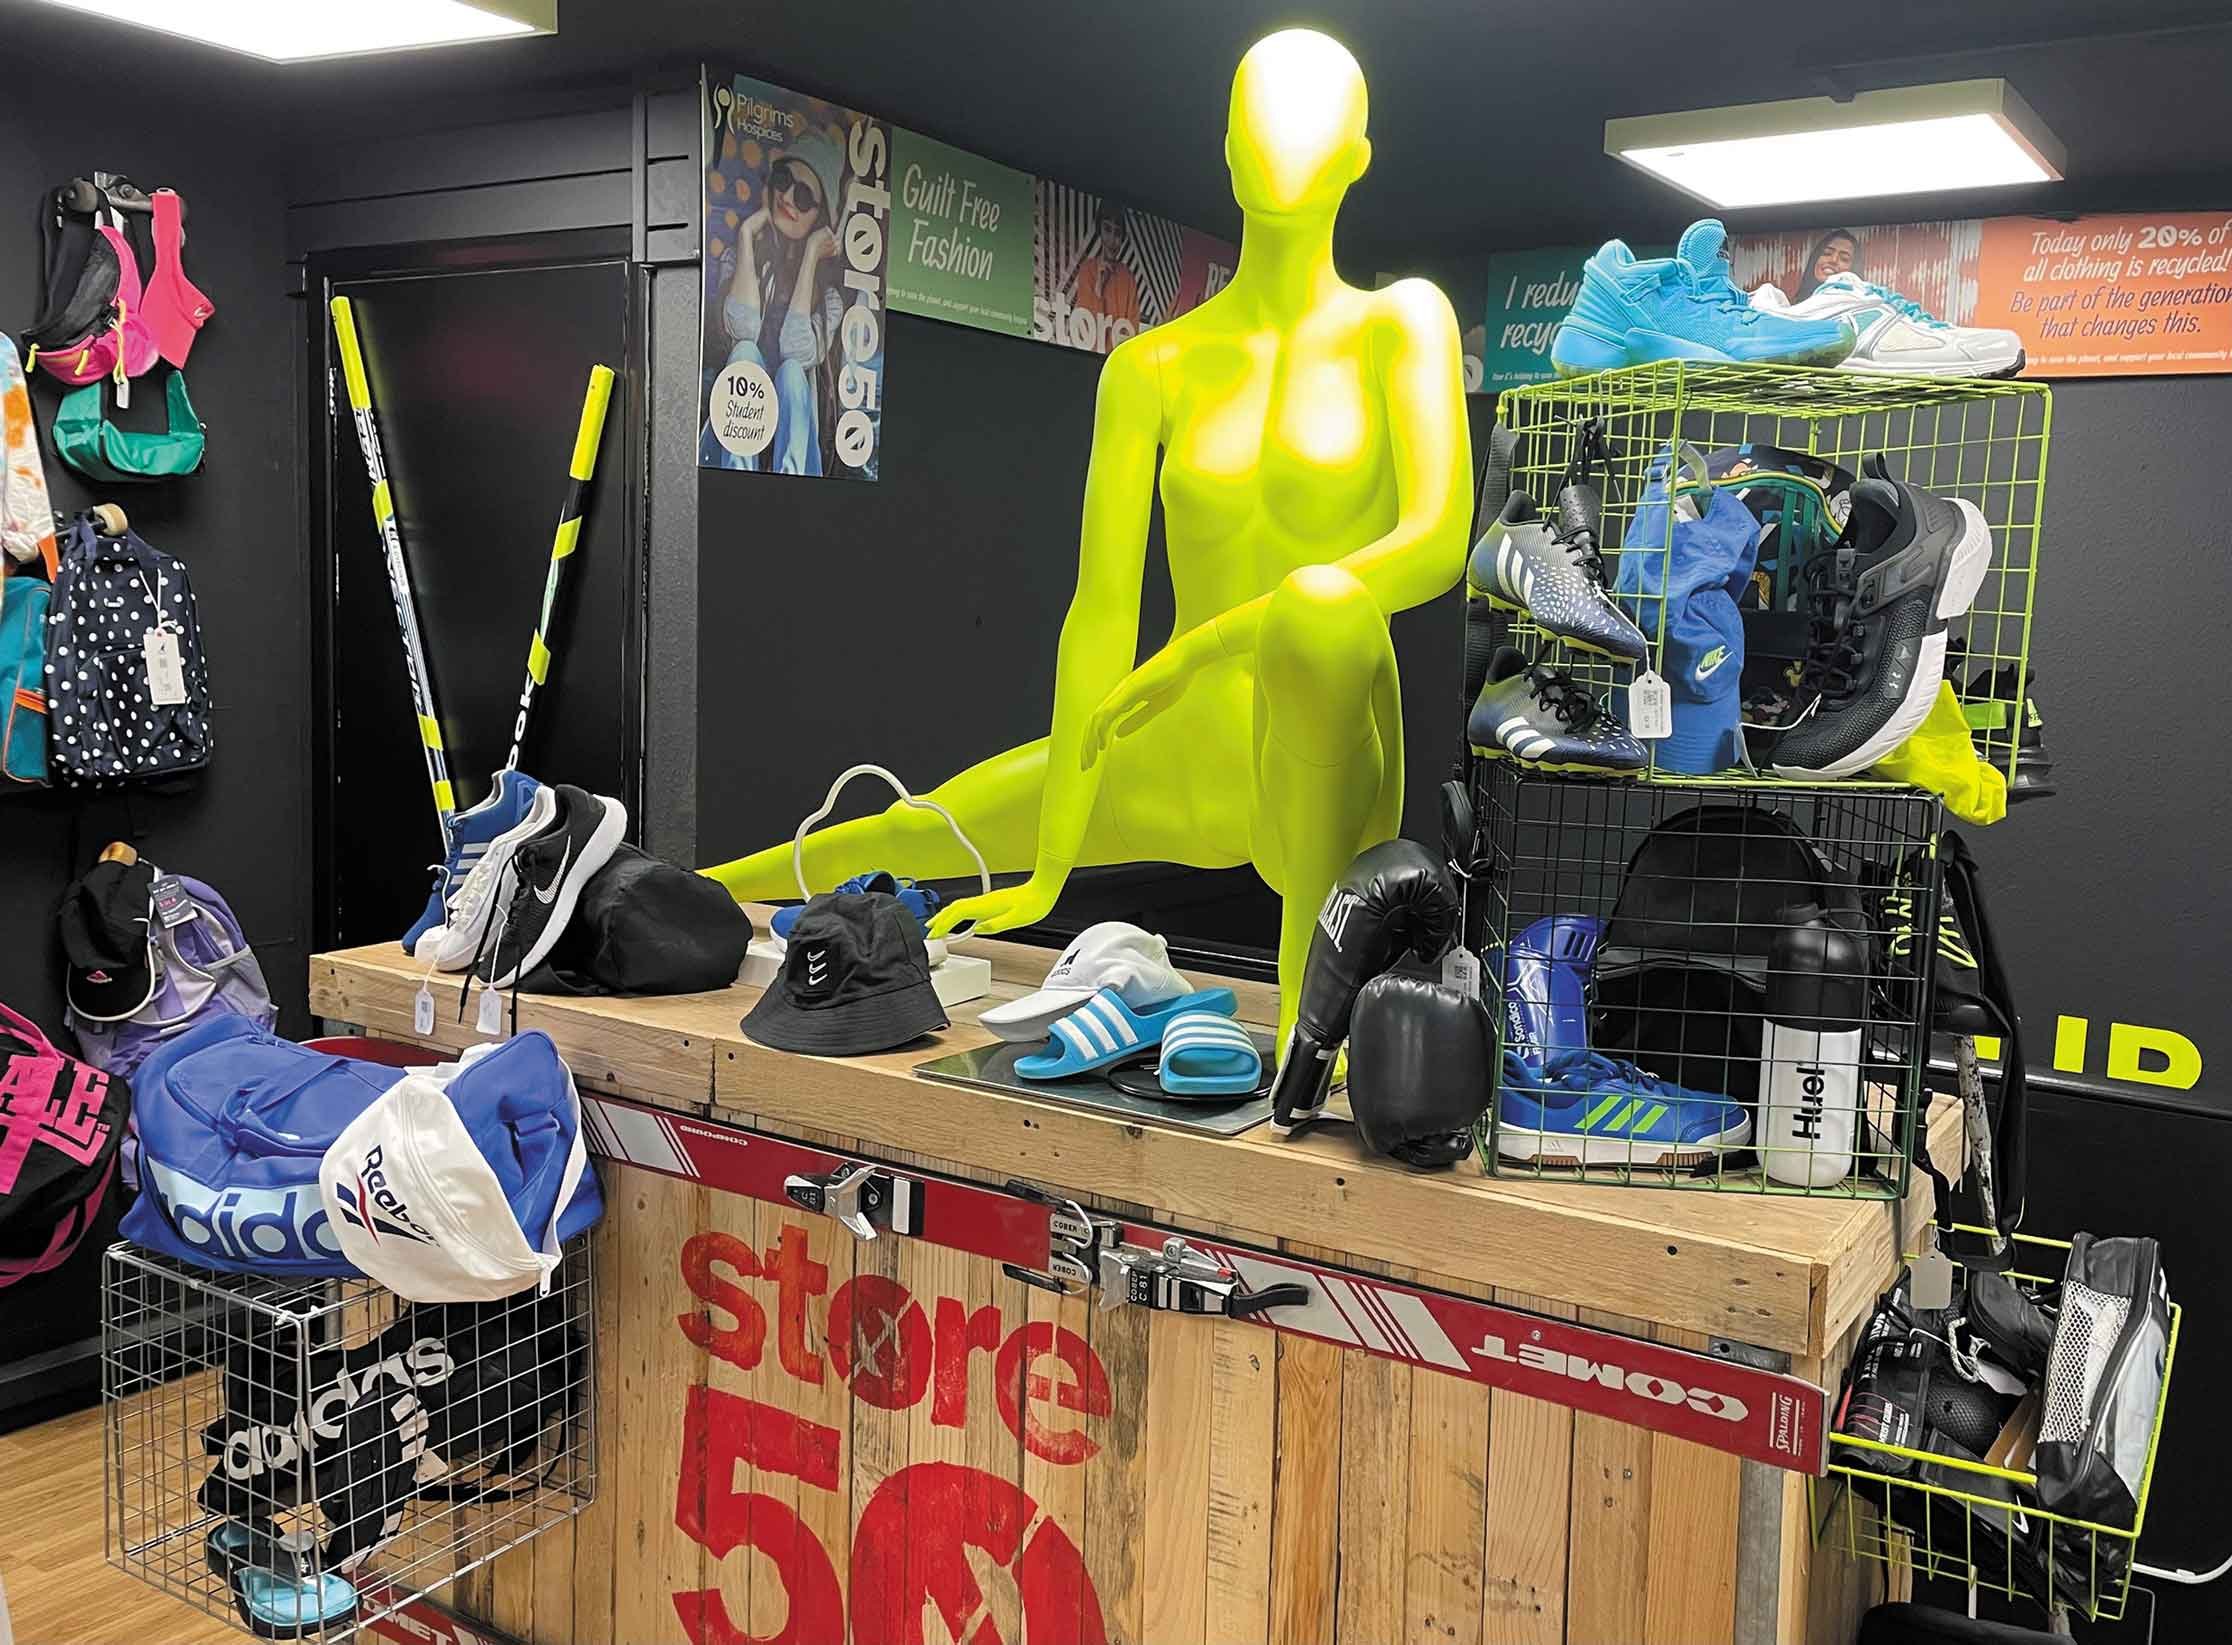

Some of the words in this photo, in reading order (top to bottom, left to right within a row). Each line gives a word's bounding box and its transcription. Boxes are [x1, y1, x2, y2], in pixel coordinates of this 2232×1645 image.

[737, 93, 794, 128] Pilgrims
[737, 117, 784, 143] Hospices
[903, 163, 956, 219] Guilt
[959, 180, 1001, 233] Free
[907, 217, 993, 281] Fashion
[2031, 230, 2087, 257] Today
[2090, 226, 2134, 254] only
[2137, 225, 2203, 249] 20%
[2207, 218, 2232, 245] of
[2023, 258, 2049, 282] all
[2049, 256, 2123, 284] clothing
[2125, 255, 2145, 277] is
[2148, 248, 2232, 278] recycled!
[1504, 275, 1518, 310] I
[2010, 290, 2032, 313] Be
[2036, 288, 2078, 317] part
[2080, 285, 2106, 310] of
[2107, 285, 2136, 308] the
[1034, 292, 1157, 354] store
[2040, 317, 2079, 339] that
[2081, 313, 2158, 341] changes
[2162, 311, 2202, 335] this.
[727, 375, 765, 400] 10%
[725, 399, 765, 420] Student
[722, 422, 766, 441] discount
[1508, 1001, 1526, 1043] Sondico
[1791, 1066, 1826, 1140] Huel
[679, 1124, 749, 1147] COMPOUND
[161, 1191, 344, 1260] dida
[1052, 1220, 1078, 1234] COBER
[677, 1223, 1113, 1466] store
[1471, 1333, 1750, 1422] COMET
[1776, 1393, 1794, 1455] SPALDING
[671, 1384, 1108, 1645] 50
